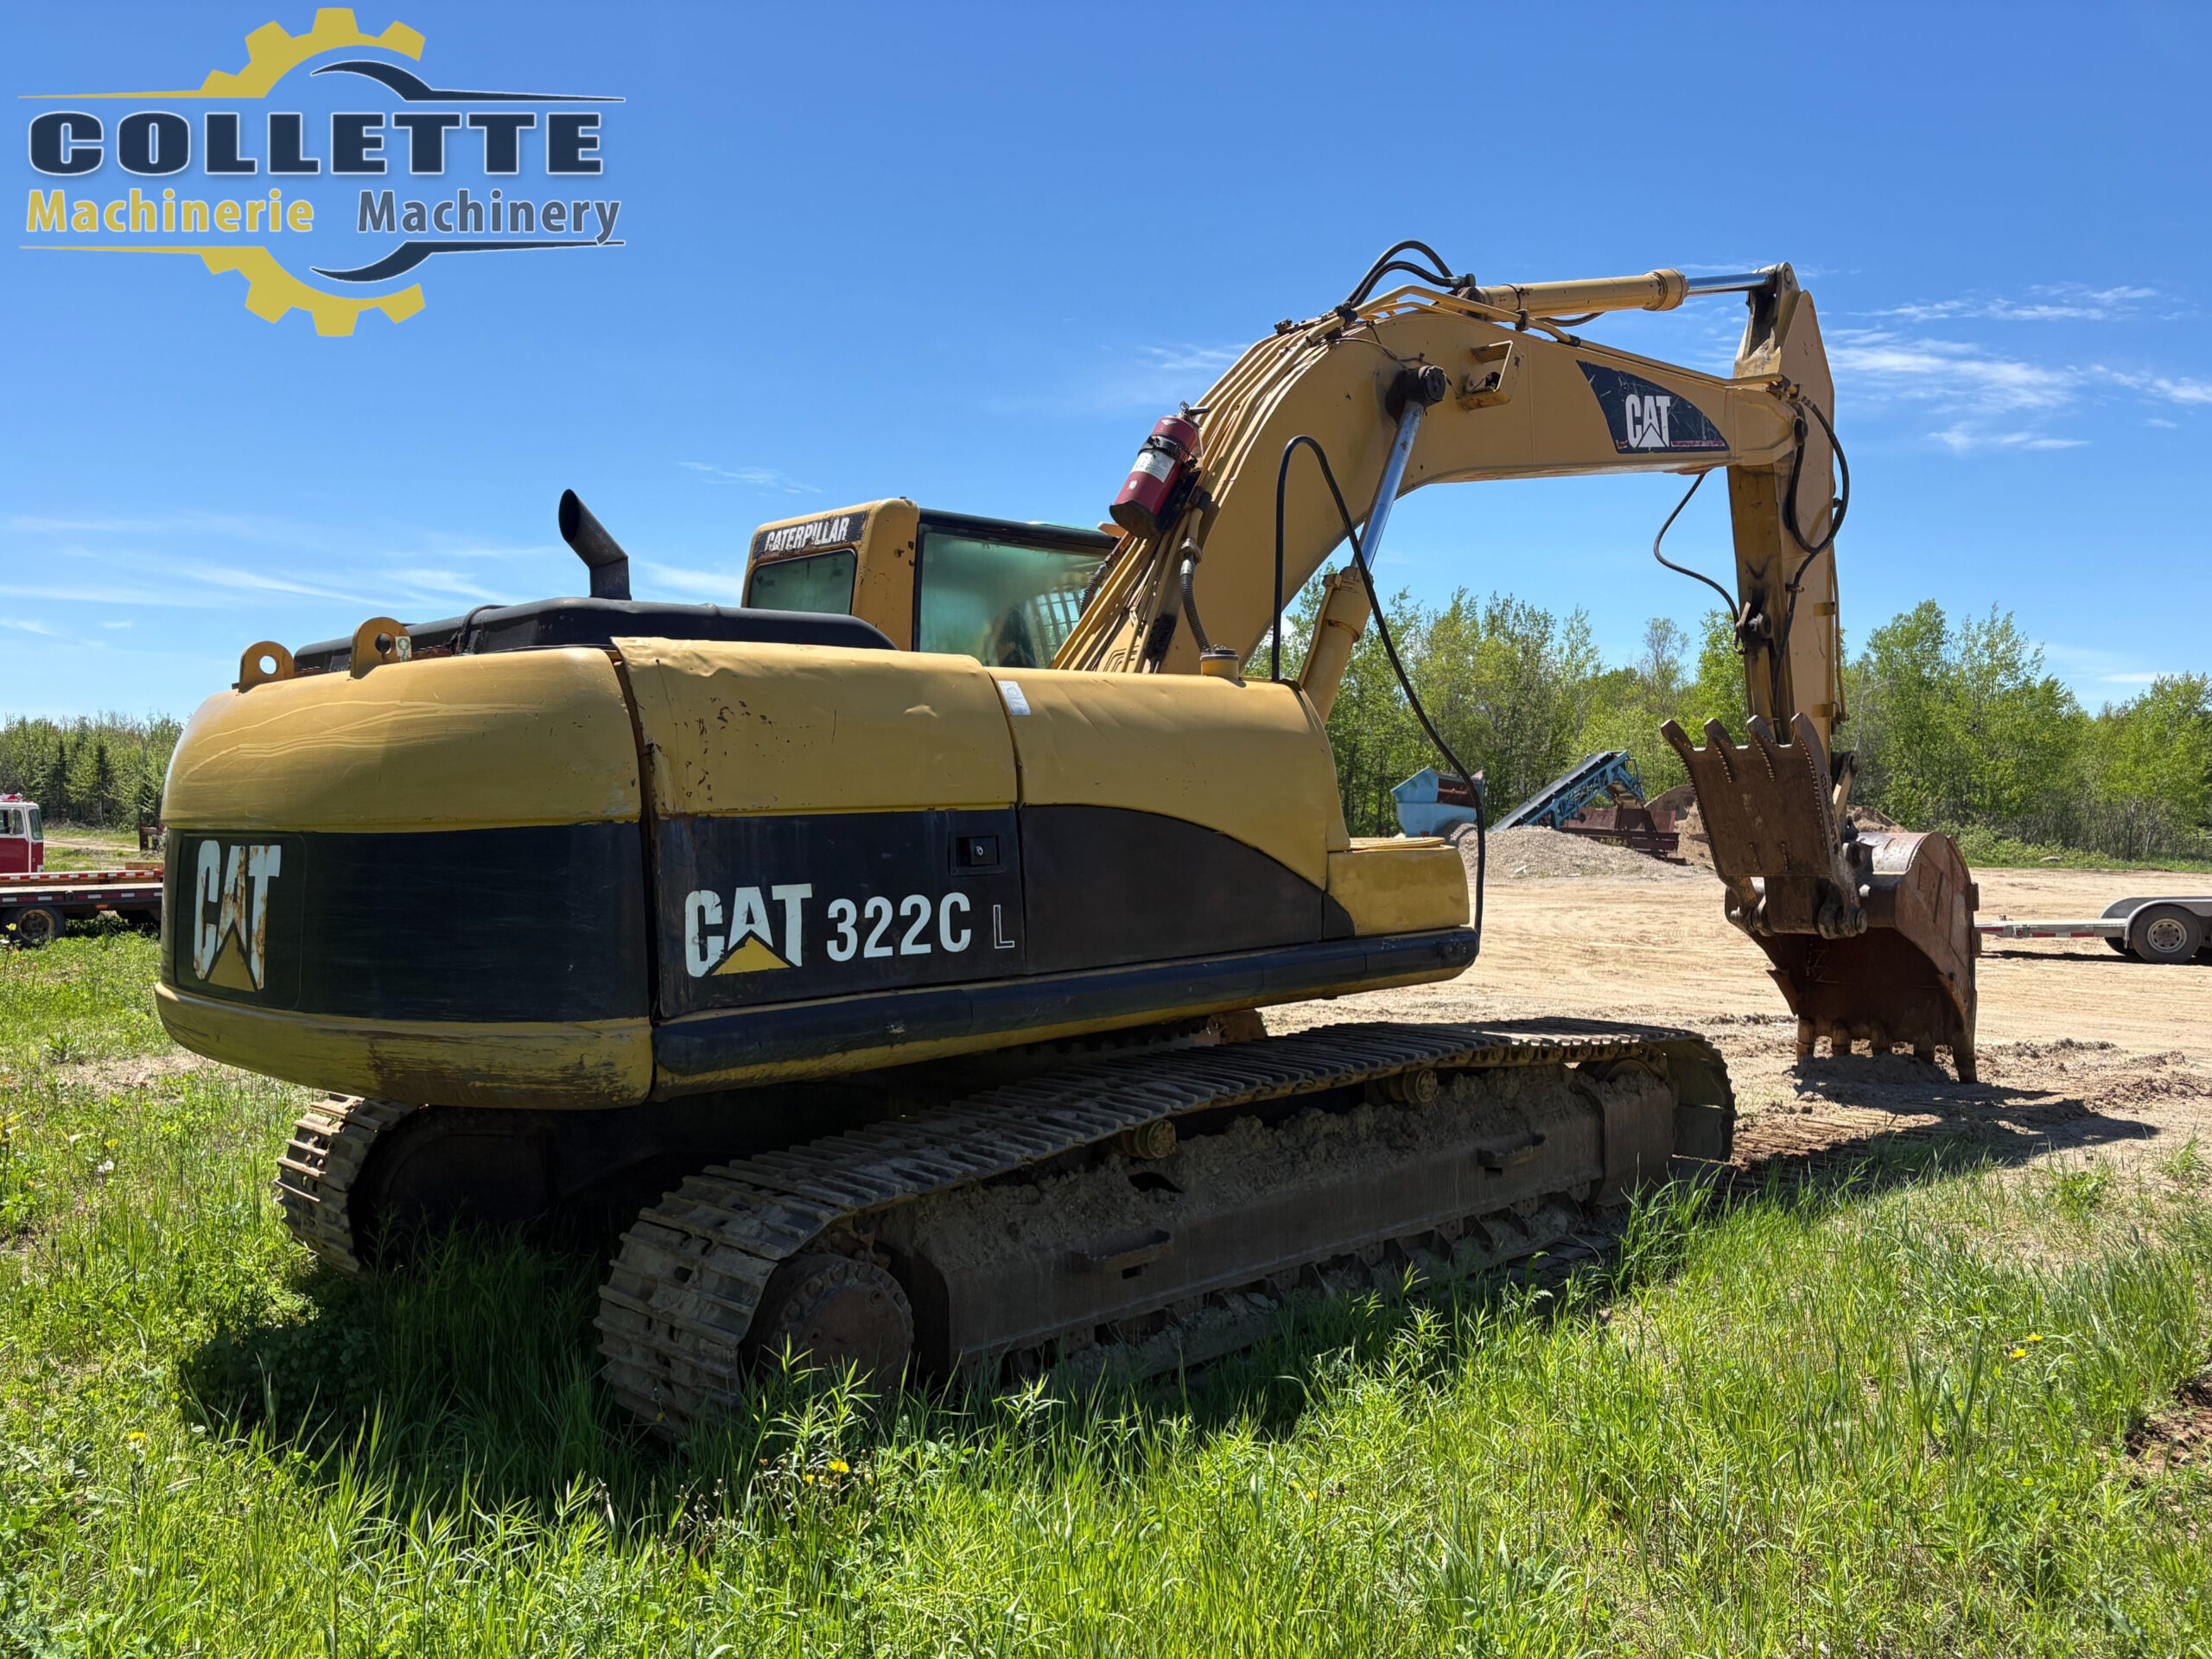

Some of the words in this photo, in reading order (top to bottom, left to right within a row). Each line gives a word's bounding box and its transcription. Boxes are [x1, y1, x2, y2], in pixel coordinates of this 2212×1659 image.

[1624, 393, 1671, 448] CAT
[764, 517, 850, 552] CATERPILLAR
[194, 839, 282, 990] CAT
[684, 882, 813, 978] CAT
[826, 892, 972, 962] 322C
[992, 904, 1015, 950] L
